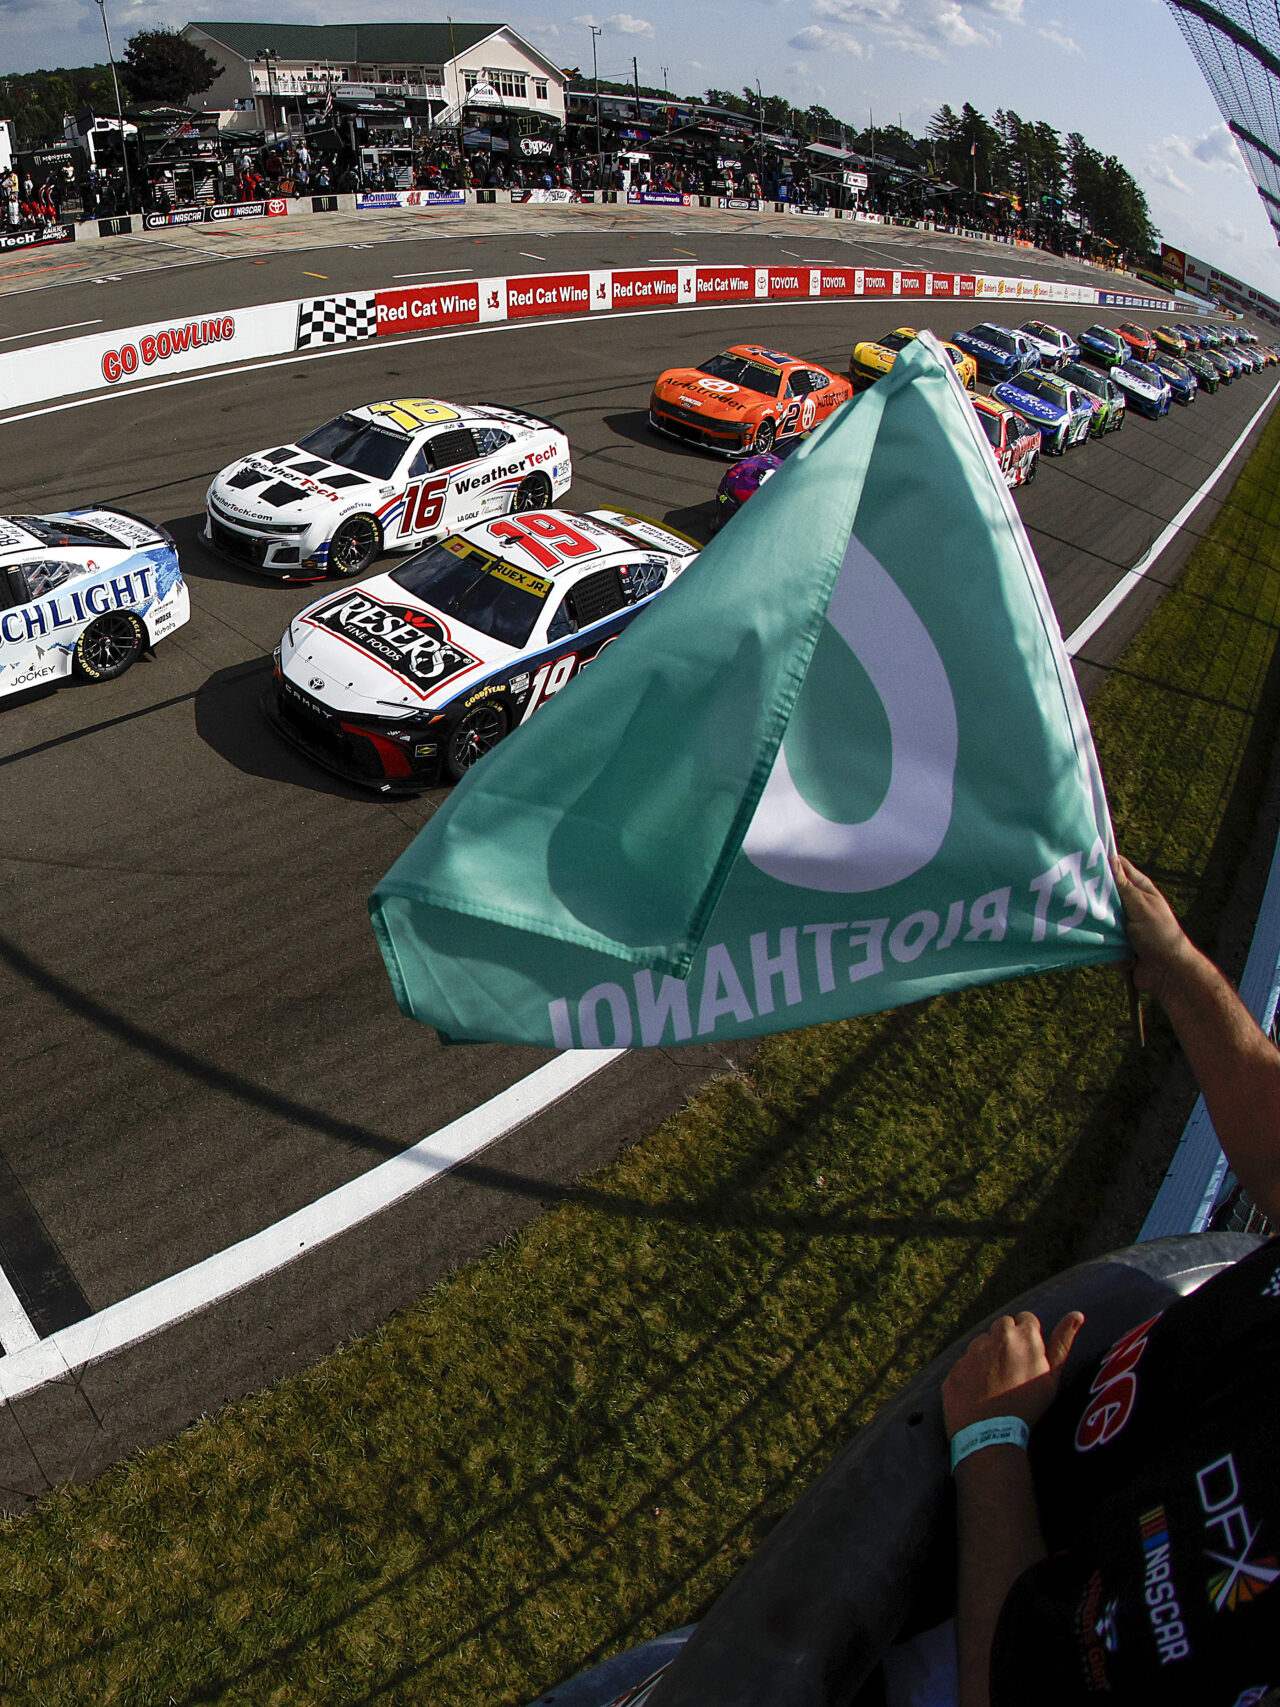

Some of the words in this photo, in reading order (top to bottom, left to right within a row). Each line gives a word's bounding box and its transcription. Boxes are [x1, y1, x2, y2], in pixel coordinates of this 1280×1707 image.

[362, 193, 398, 202] MOHAWK
[428, 191, 460, 200] MOHAWK
[174, 211, 202, 224] NASCAR
[236, 203, 263, 216] NASCAR
[613, 282, 633, 297] Red
[635, 281, 652, 296] Cat
[654, 280, 677, 295] Wine
[697, 278, 713, 292] Red
[715, 278, 729, 291] Cat
[730, 277, 749, 290] Wine
[771, 276, 799, 289] TOYOTA
[822, 276, 846, 288] TOYOTA
[865, 277, 886, 288] TOYOTA
[902, 278, 920, 289] TOYOTA
[933, 279, 948, 290] TOYOTA
[509, 289, 533, 306] Red
[536, 288, 558, 304] Cat
[560, 286, 588, 302] Wine
[377, 302, 408, 322] Red
[411, 299, 438, 317] Cat
[440, 296, 477, 314] Wine
[101, 344, 138, 384] GO
[140, 315, 236, 366] BOWLING
[664, 377, 748, 411] Autotrader
[366, 397, 462, 432] 16
[780, 401, 802, 437] 2
[455, 444, 558, 496] WeatherTech
[211, 489, 273, 522] WeatherTech.com
[339, 502, 372, 516] GOODYEAR
[397, 473, 451, 539] 16
[464, 510, 480, 521] GOLF
[486, 512, 603, 572] 19
[127, 615, 142, 639] EAGLE
[343, 623, 368, 641] FINE
[365, 636, 404, 663] FOODS
[77, 632, 100, 678] GOODYEAR
[11, 665, 56, 687] JOCKEY
[284, 683, 334, 721] CAMRY
[464, 684, 506, 709] GOODYEAR
[1144, 1543, 1190, 1665] NASCAR
